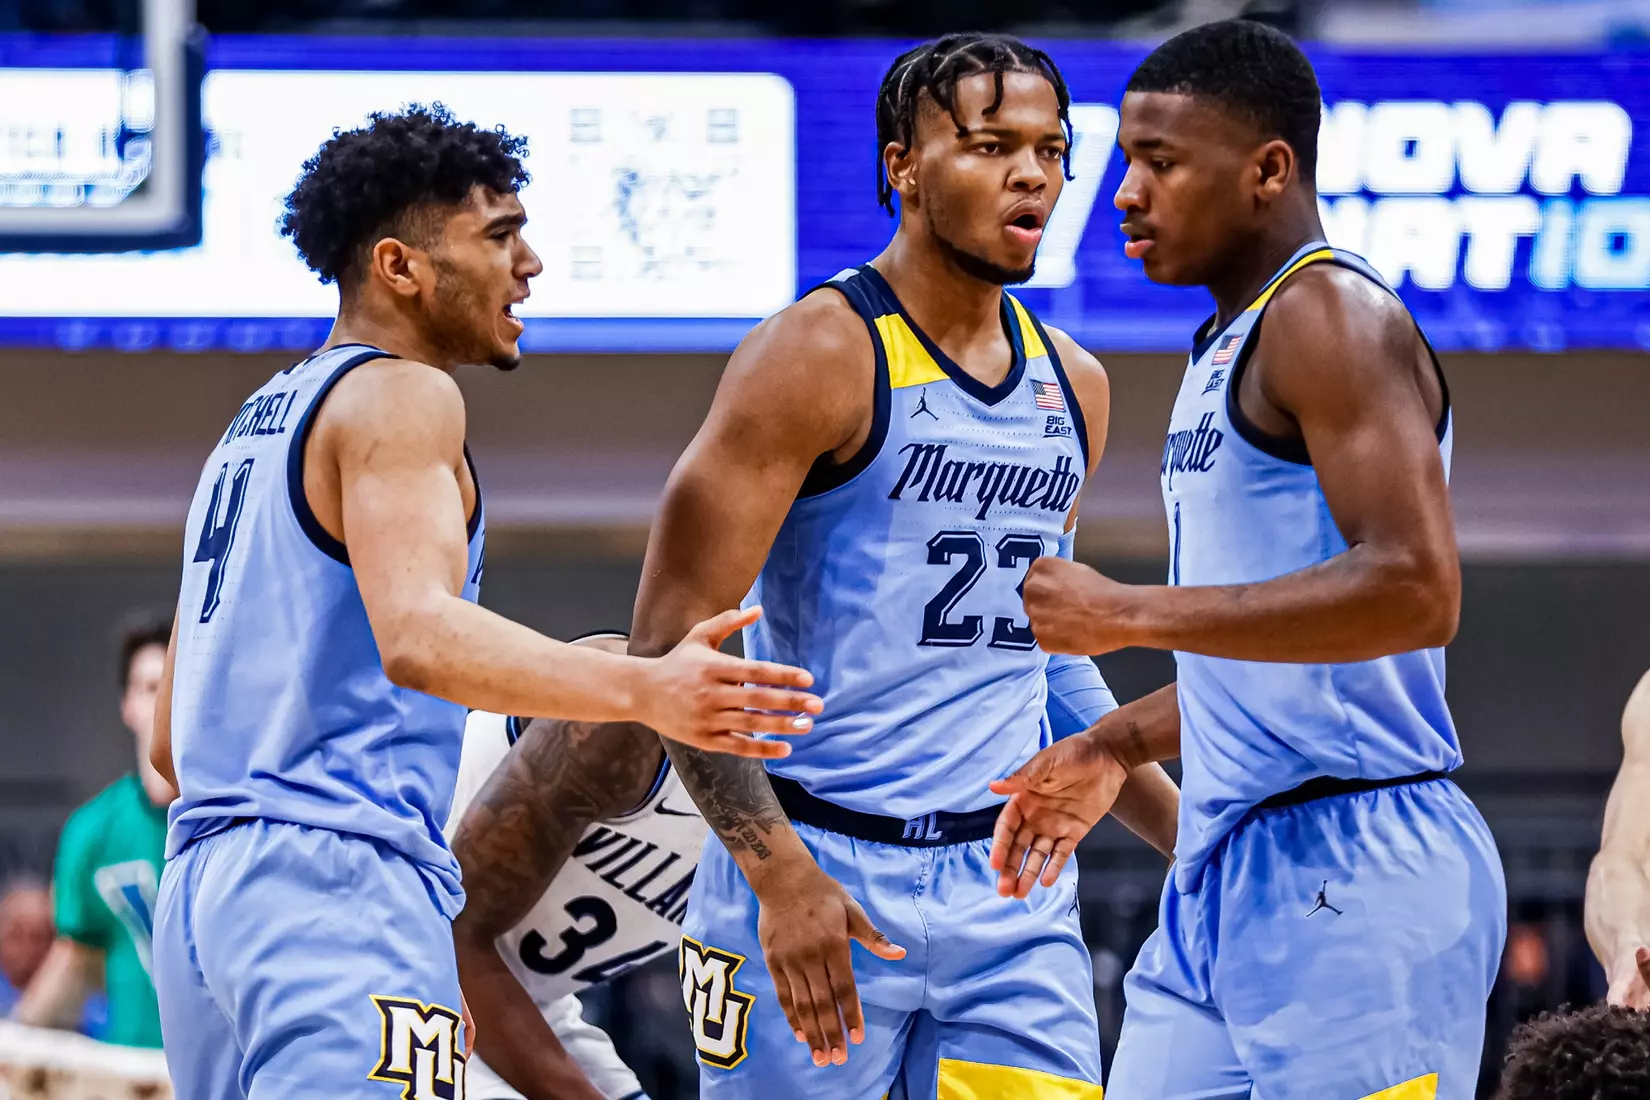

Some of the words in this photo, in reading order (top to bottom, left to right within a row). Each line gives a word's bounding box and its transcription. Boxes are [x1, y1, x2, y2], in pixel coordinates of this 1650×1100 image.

[1045, 425, 1072, 435] EAST
[1046, 415, 1065, 425] BIG
[1161, 412, 1224, 492] rquette
[888, 443, 1079, 520] Marquette
[193, 458, 255, 624] 4
[917, 531, 1045, 651] 23
[368, 995, 466, 1100] MU
[681, 936, 755, 1068] MU
